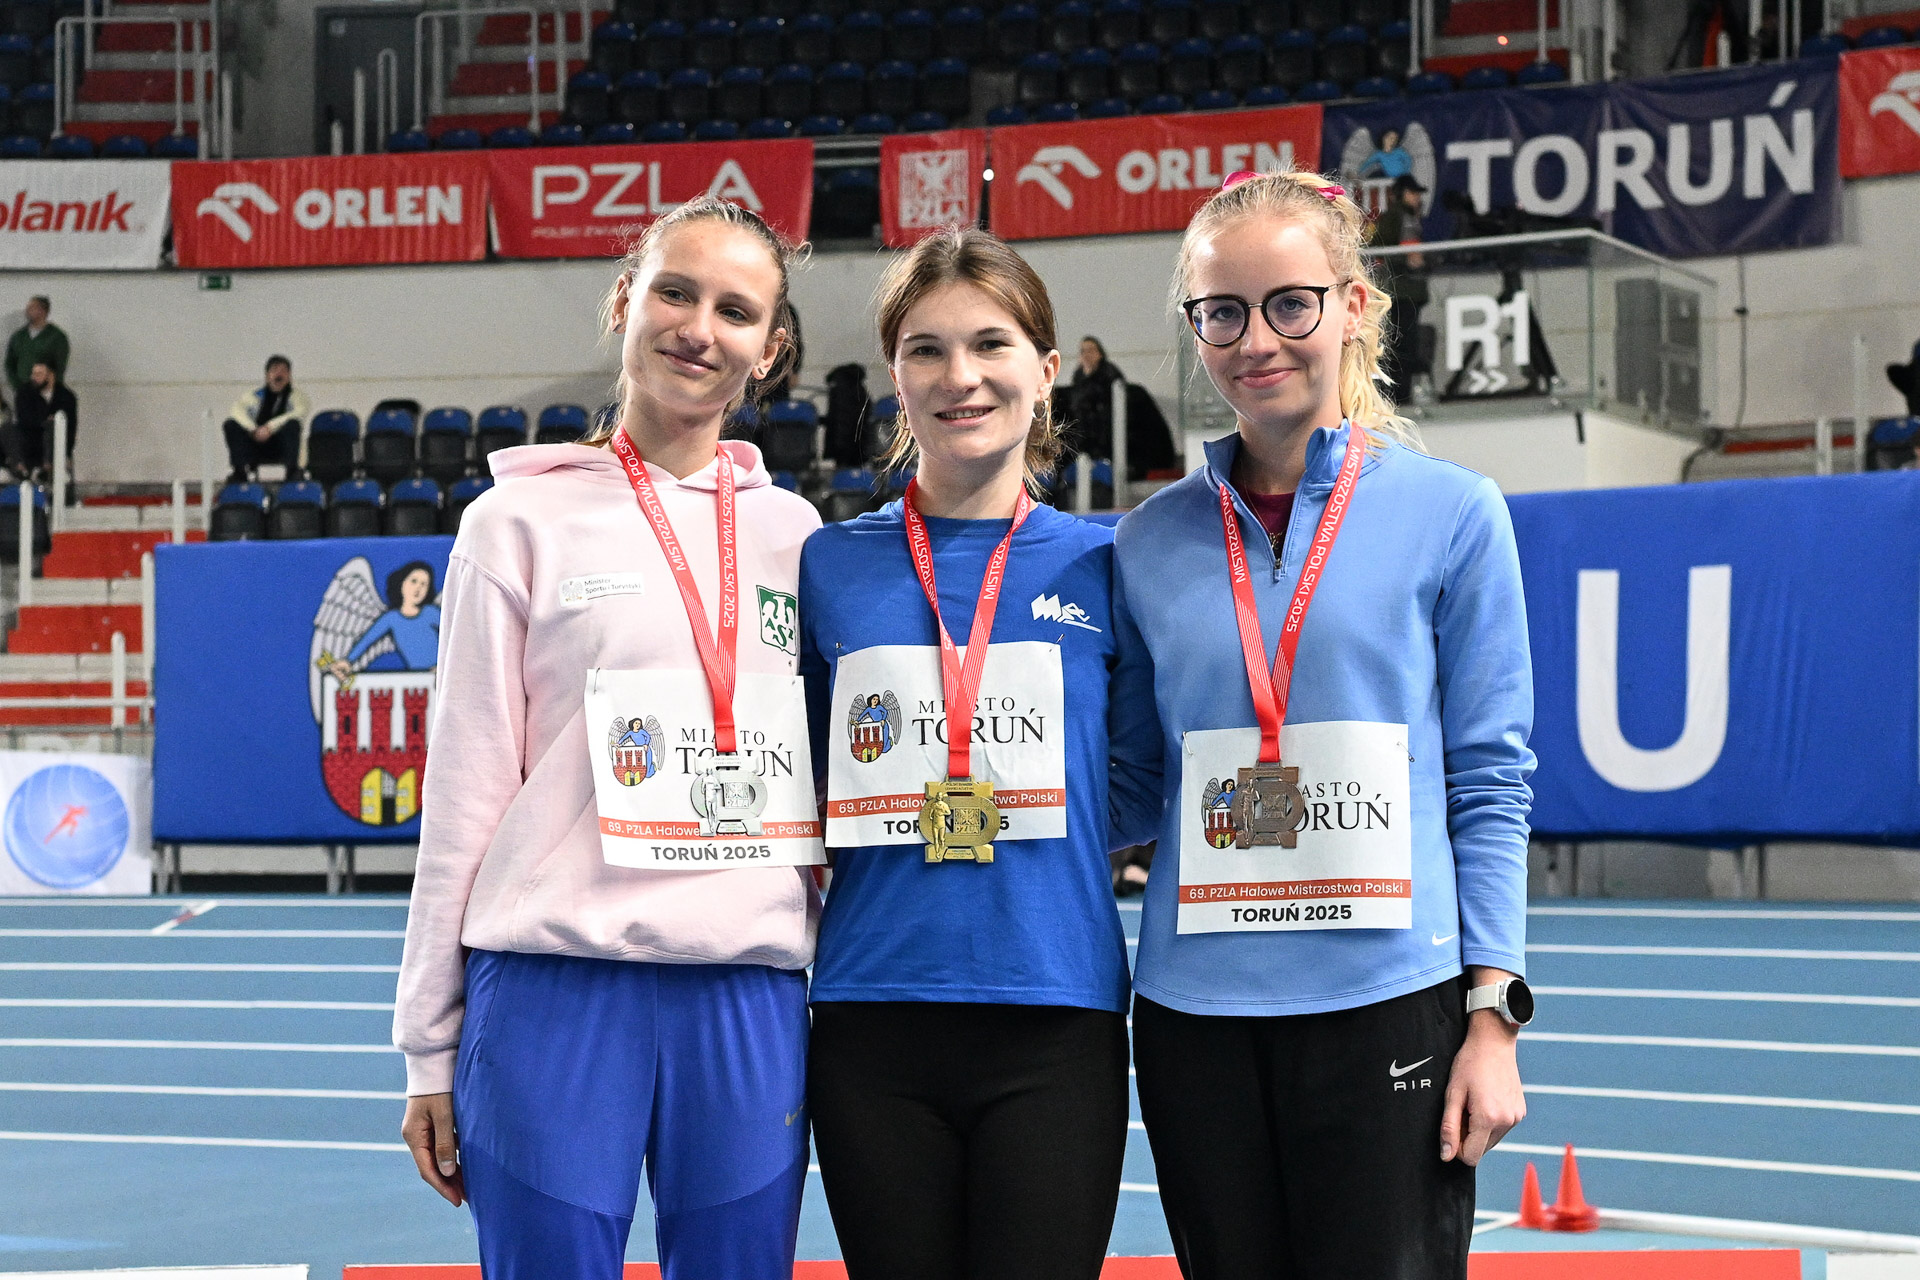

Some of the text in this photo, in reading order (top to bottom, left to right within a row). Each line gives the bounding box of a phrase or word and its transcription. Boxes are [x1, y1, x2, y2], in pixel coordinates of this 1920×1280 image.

[1445, 80, 1816, 217] TORUŃ
[1115, 140, 1295, 194] ORLEN
[532, 159, 764, 220] PZLA
[293, 185, 463, 230] ORLEN
[1445, 290, 1530, 371] R1
[616, 436, 686, 571] MISTRZOSTWA POLSKI
[721, 455, 735, 628] MISTRZOSTWA POLSKI 2025
[1286, 445, 1361, 632] MISTRZOSTWA POLSKI 2025
[681, 728, 765, 745] MITO
[839, 803, 857, 815] 69.
[860, 800, 887, 812] PZLA
[891, 797, 927, 809] Halow
[1023, 791, 1058, 804] Polski
[1302, 781, 1361, 798] ASTO
[608, 821, 624, 834] 69.
[626, 824, 653, 836] PZLA
[656, 825, 699, 836] Halowe
[779, 825, 814, 836] Polski
[651, 843, 771, 861] TORUŃ 2025
[1189, 881, 1403, 899] 69. PZLA Halowe Mistrzostwa Polski
[1231, 903, 1352, 922] TORUŃ 2025
[1393, 1079, 1432, 1092] AIR
